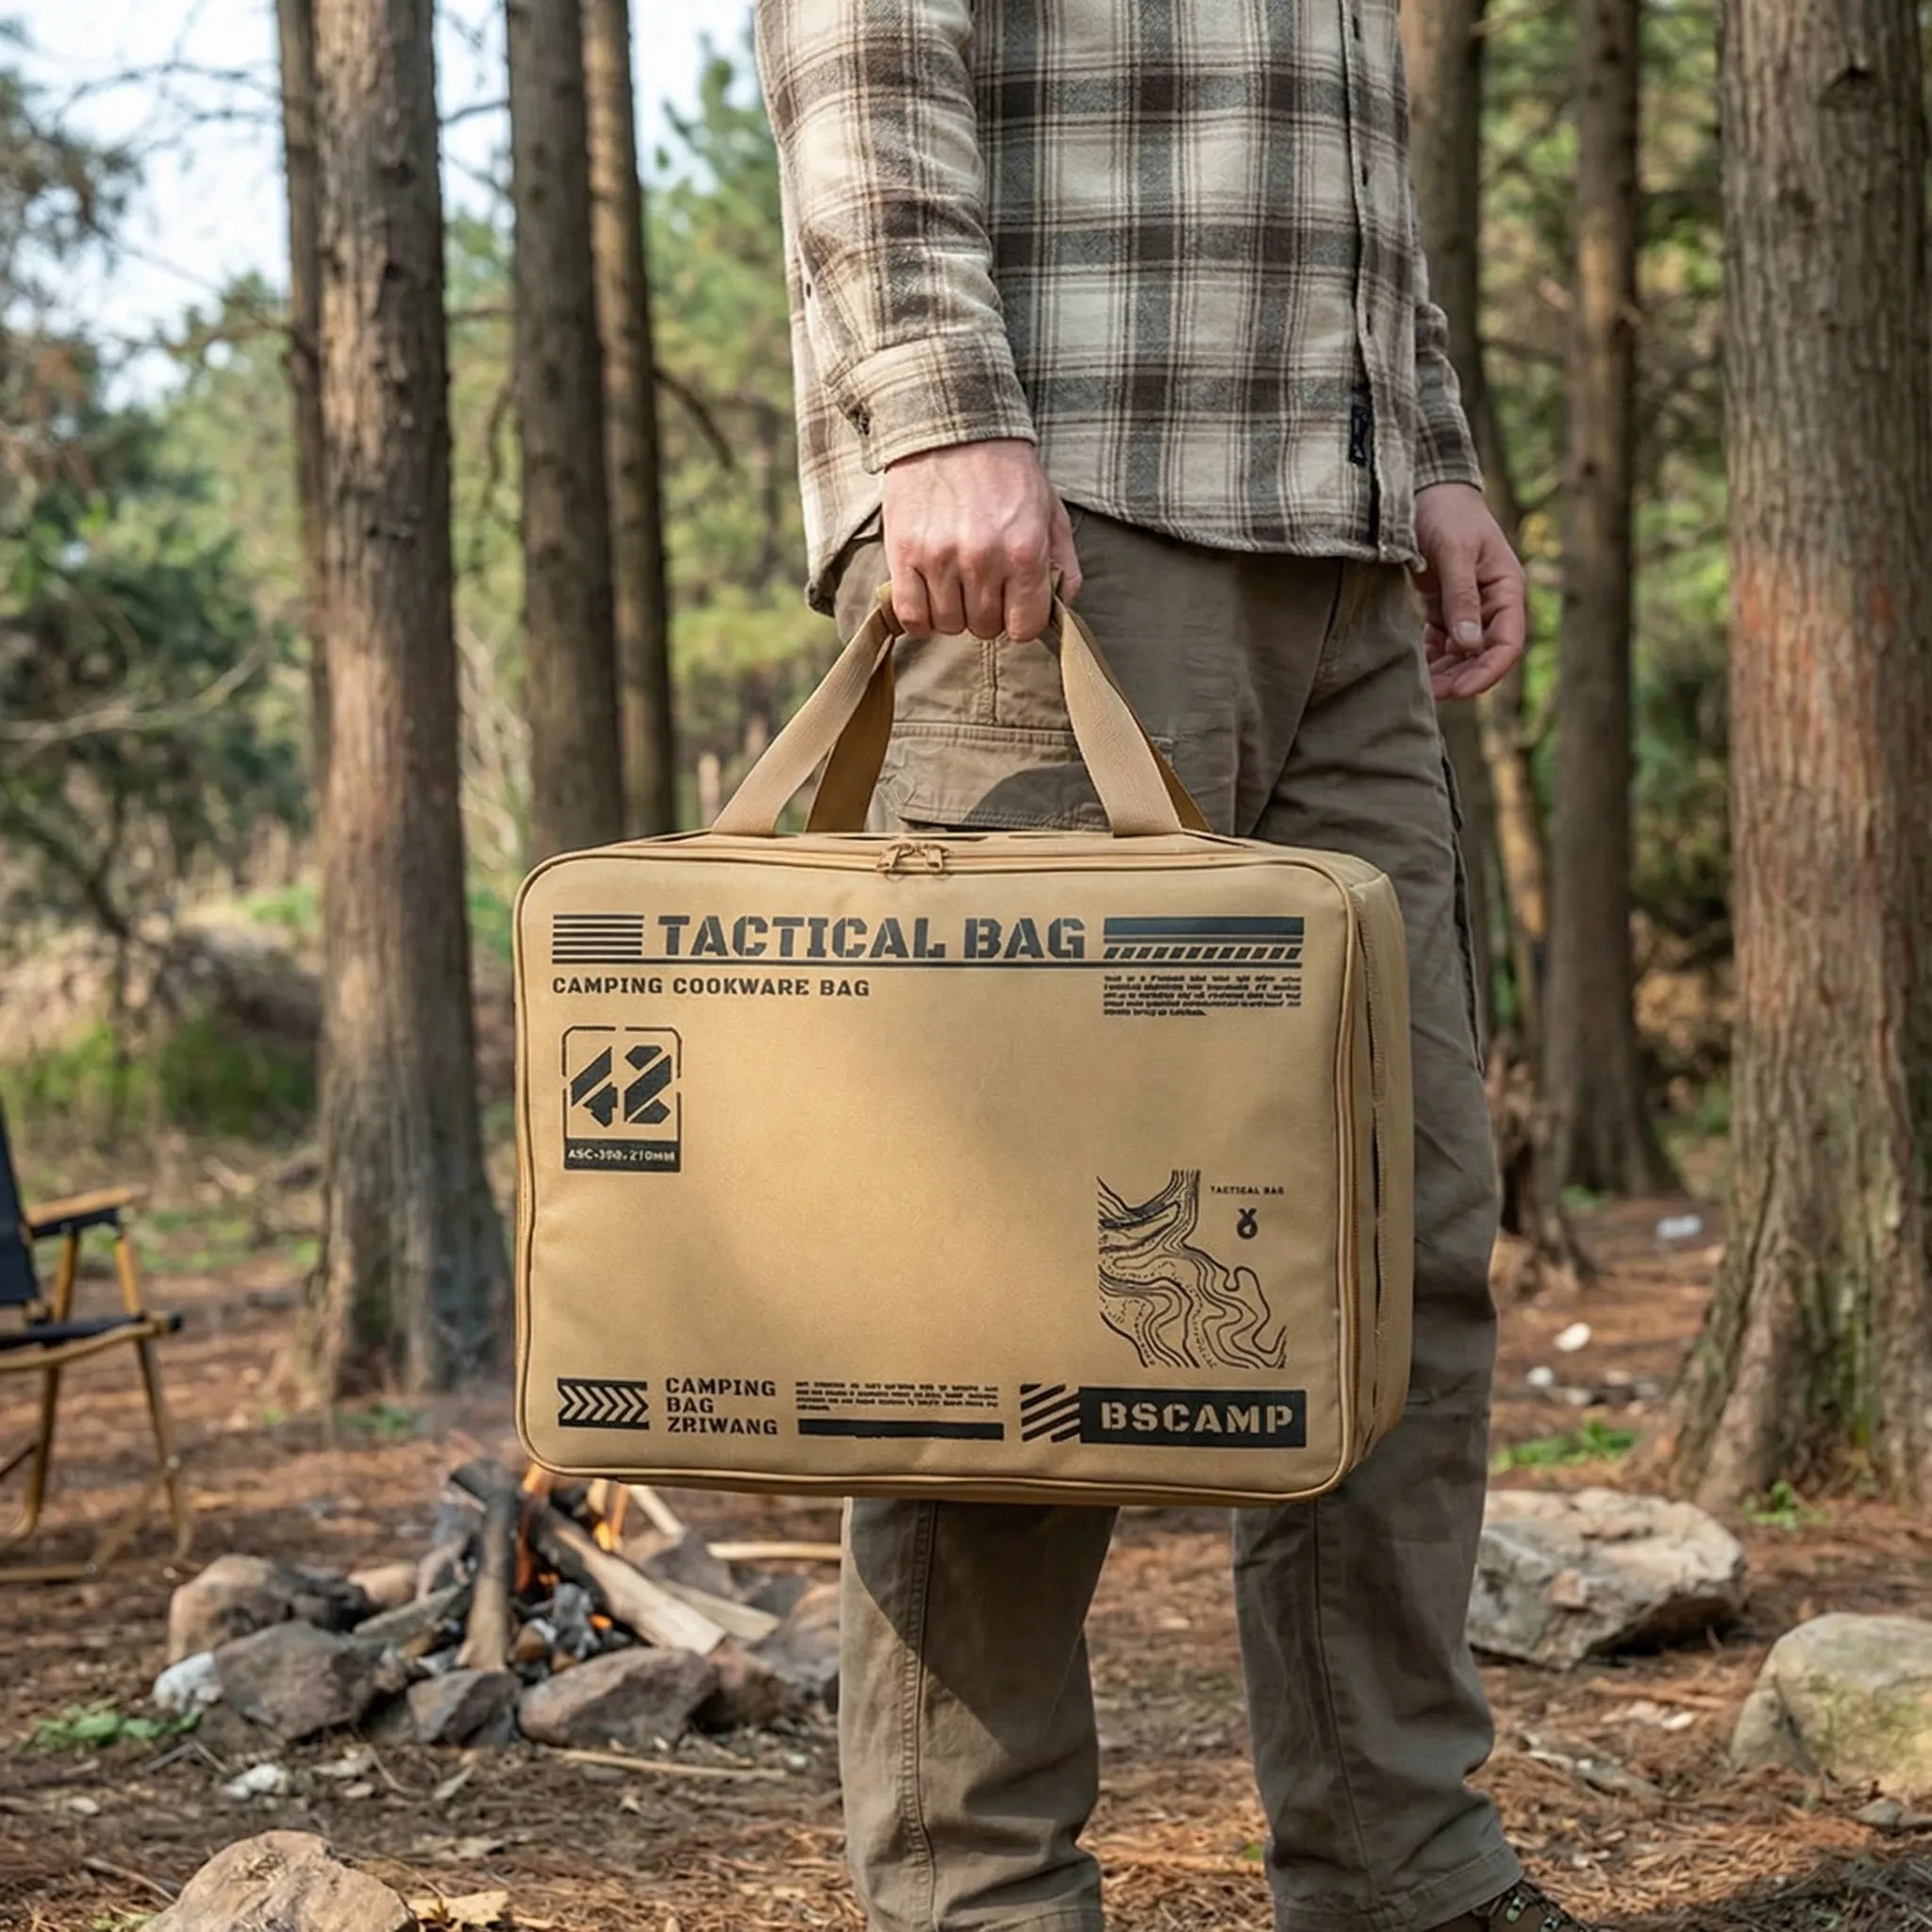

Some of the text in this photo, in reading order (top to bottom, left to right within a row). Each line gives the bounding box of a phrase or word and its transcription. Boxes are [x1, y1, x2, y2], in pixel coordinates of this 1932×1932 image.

[658, 915, 1085, 959] TACTICAL BAG
[553, 977, 870, 997] CAMPING COOKWARE BAG
[570, 1045, 673, 1128] 42
[666, 1377, 776, 1397] CAMPING
[666, 1397, 714, 1414] BAG
[667, 1416, 778, 1436] ZRIWANG
[1101, 1402, 1293, 1434] BSCAMP
